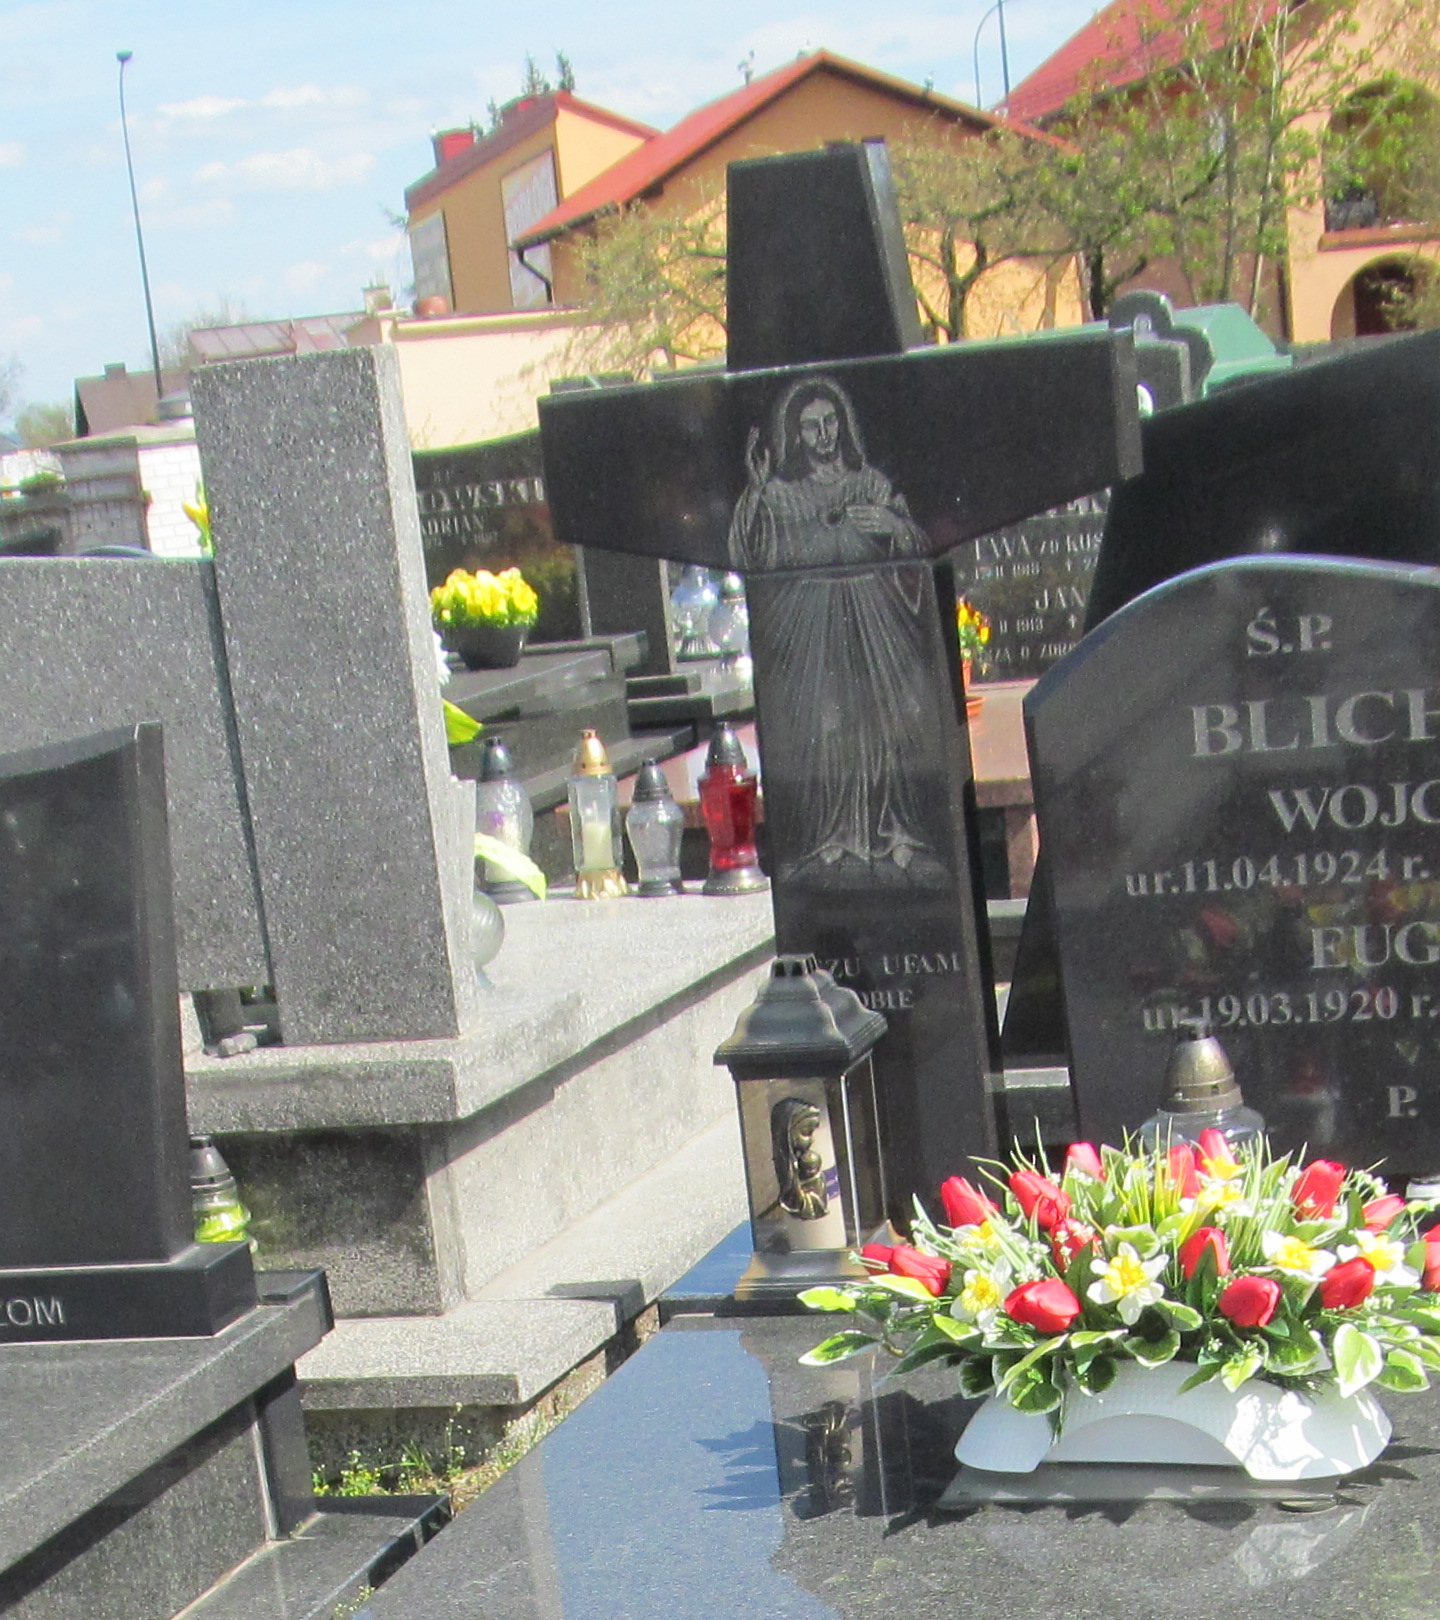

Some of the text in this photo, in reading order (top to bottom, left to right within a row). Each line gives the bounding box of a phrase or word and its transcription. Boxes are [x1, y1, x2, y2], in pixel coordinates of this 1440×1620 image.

[1124, 848, 1431, 896] ur.11.04.1924 r.
[882, 951, 962, 976] UFAM
[1141, 985, 1399, 1031] ur19.03.1920
